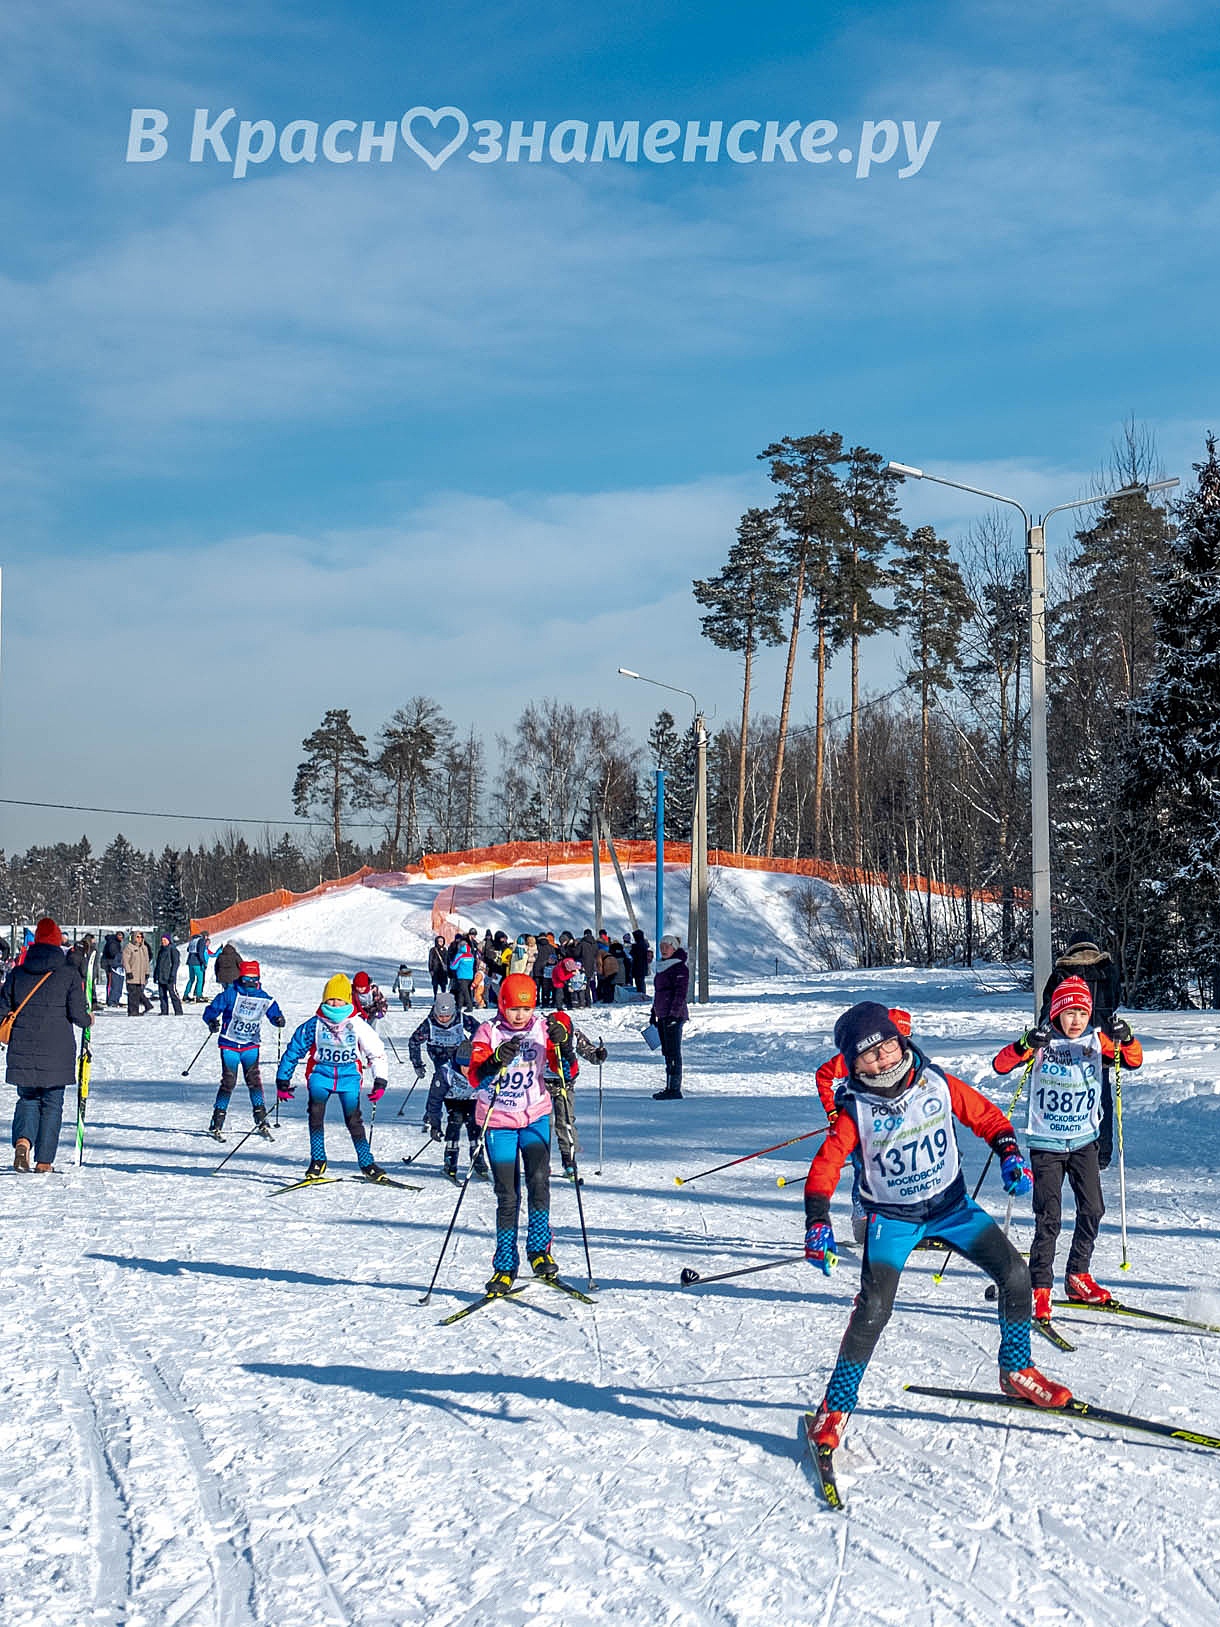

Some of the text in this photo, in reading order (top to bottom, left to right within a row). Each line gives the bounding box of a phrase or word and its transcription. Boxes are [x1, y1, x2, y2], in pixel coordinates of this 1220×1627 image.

[1043, 1045, 1072, 1060] ЛЫНЯ
[488, 1096, 517, 1107] ОЛАСТЬ
[1036, 1088, 1095, 1113] 13878
[1044, 1113, 1088, 1122] МОСКОВСКАЯ
[1050, 1123, 1081, 1132] ОБЛАСТЬ
[873, 1128, 947, 1177] 13719
[887, 1160, 945, 1187] МОСКОВСКАЯ
[900, 1177, 942, 1196] ОБЛАСТЬ
